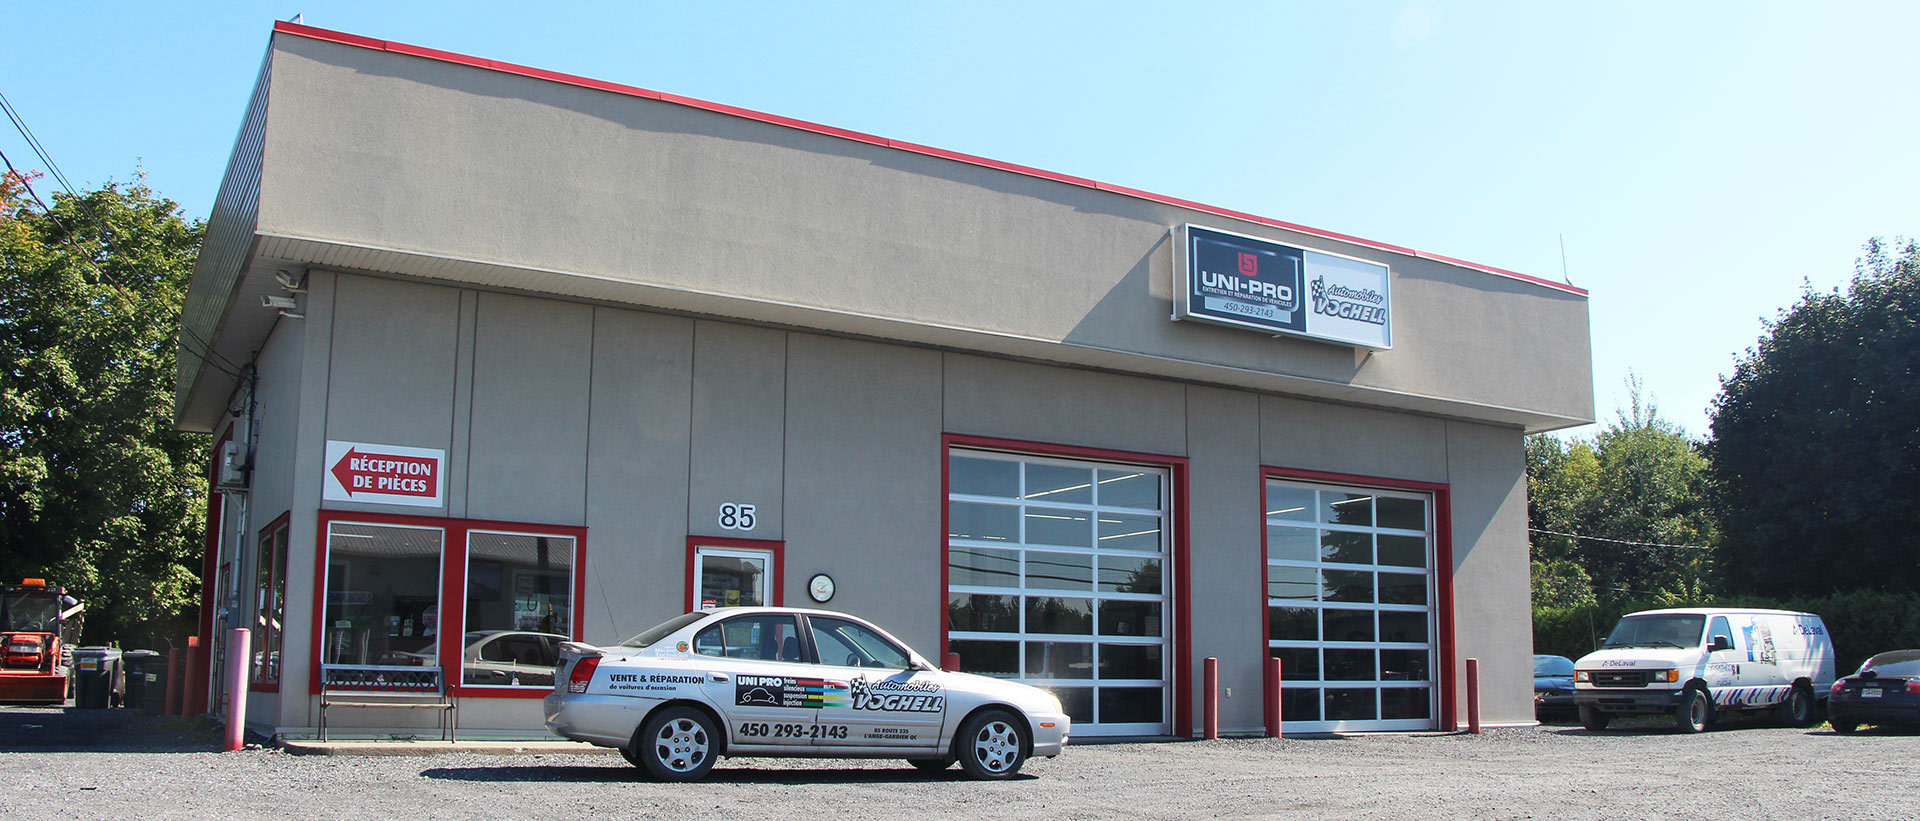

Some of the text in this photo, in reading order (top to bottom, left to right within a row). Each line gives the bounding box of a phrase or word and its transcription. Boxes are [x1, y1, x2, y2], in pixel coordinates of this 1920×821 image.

[1202, 270, 1292, 301] UNI-PRO
[1234, 291, 1262, 303] RÉPARATION
[1327, 284, 1384, 305] Automobiles
[1224, 302, 1274, 318] 450-293-2143
[1314, 298, 1386, 325] VOGHELL
[350, 455, 431, 476] RÉCEPTION
[353, 474, 427, 492] DE PIÈCES
[720, 504, 755, 529] 85
[1799, 624, 1824, 635] DeLaval
[610, 673, 704, 684] VENTE & RÉPARATION
[738, 676, 782, 687] UNI PRO
[871, 679, 941, 693] Automobiles
[852, 693, 943, 713] VOGHELL
[740, 723, 848, 739] 450 293-2143
